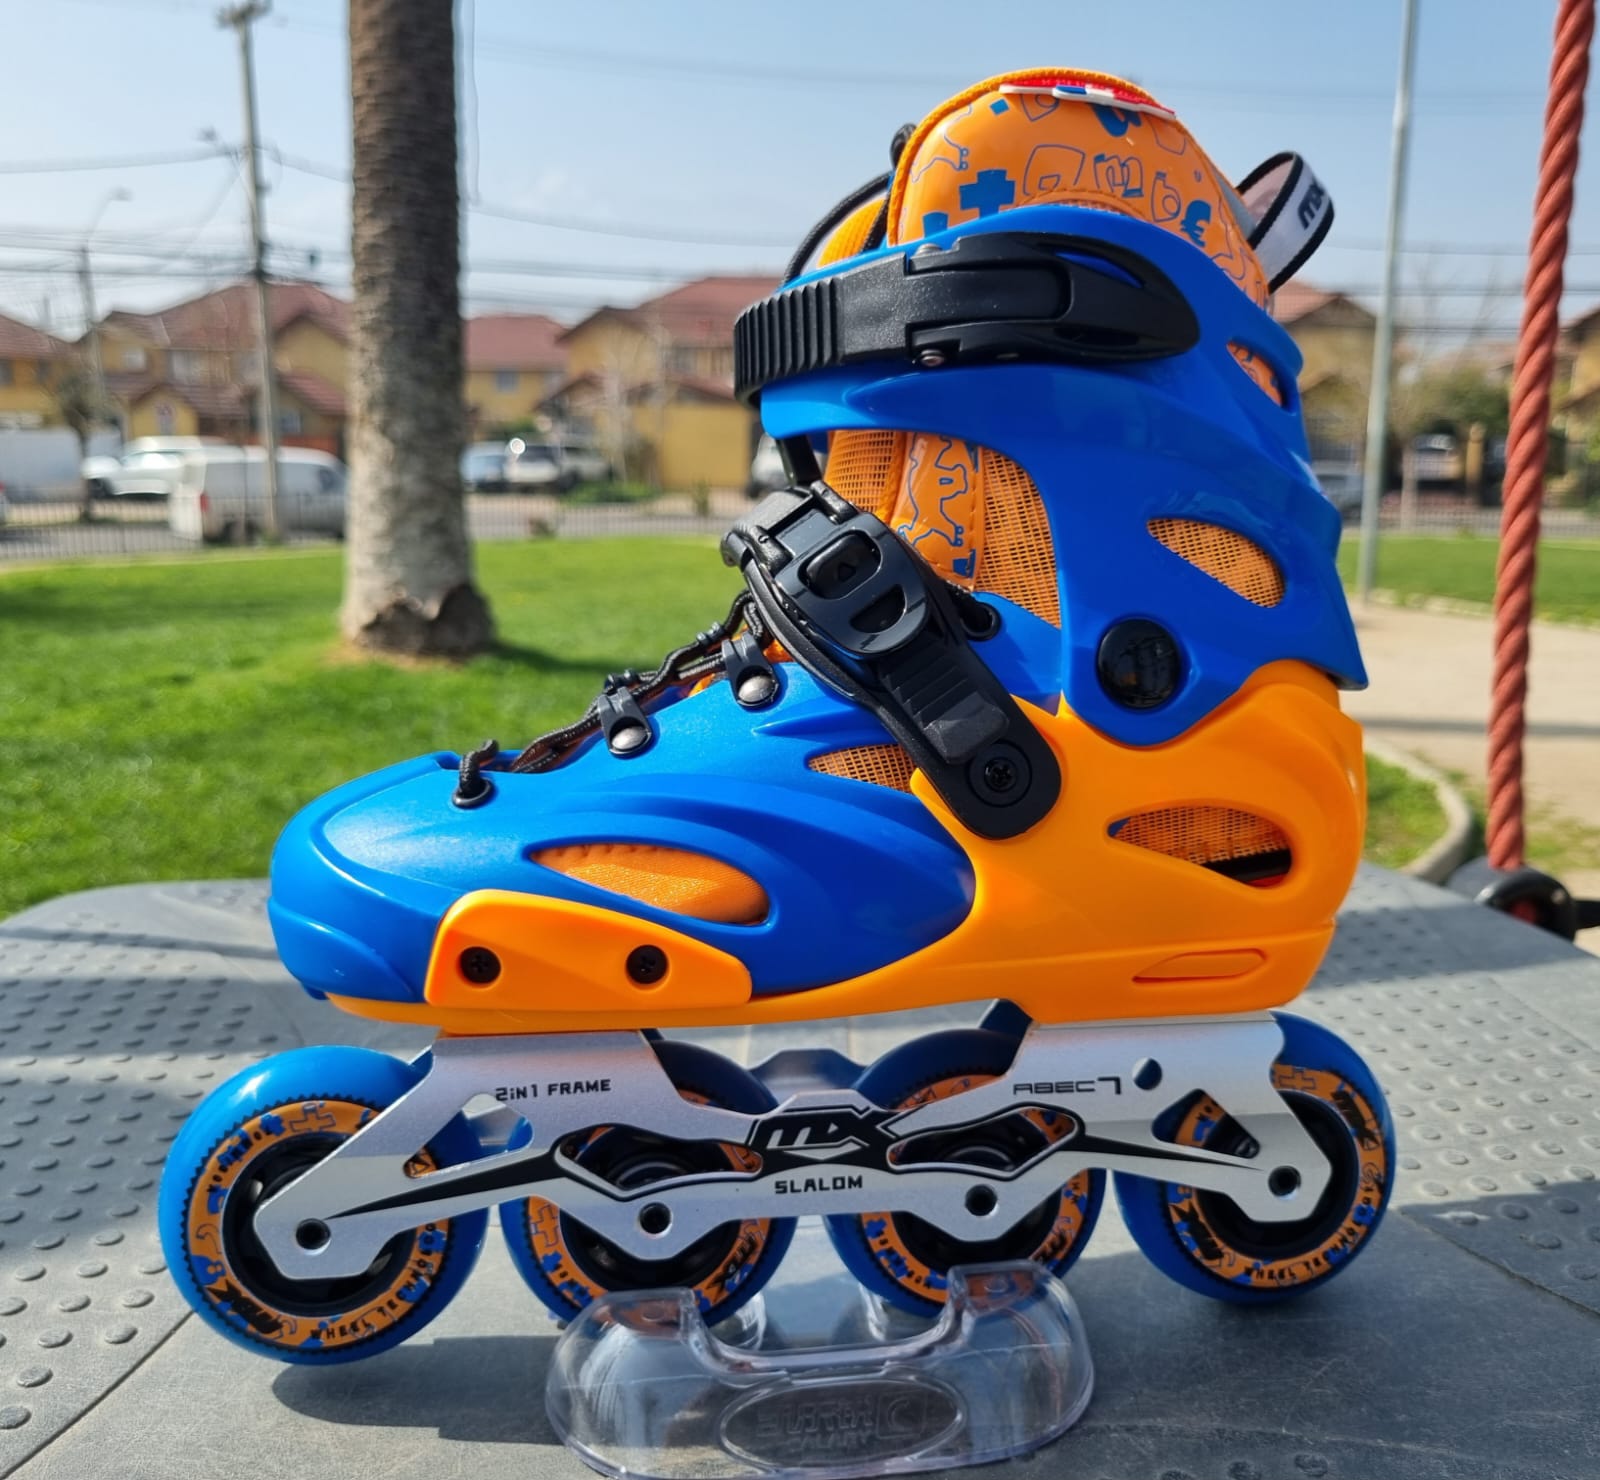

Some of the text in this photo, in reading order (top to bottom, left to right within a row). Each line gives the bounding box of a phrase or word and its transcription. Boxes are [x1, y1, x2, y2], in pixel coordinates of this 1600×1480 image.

[547, 1079, 612, 1097] FRAME
[774, 1175, 863, 1195] SLALOM
[309, 1318, 373, 1340] WHEEL
